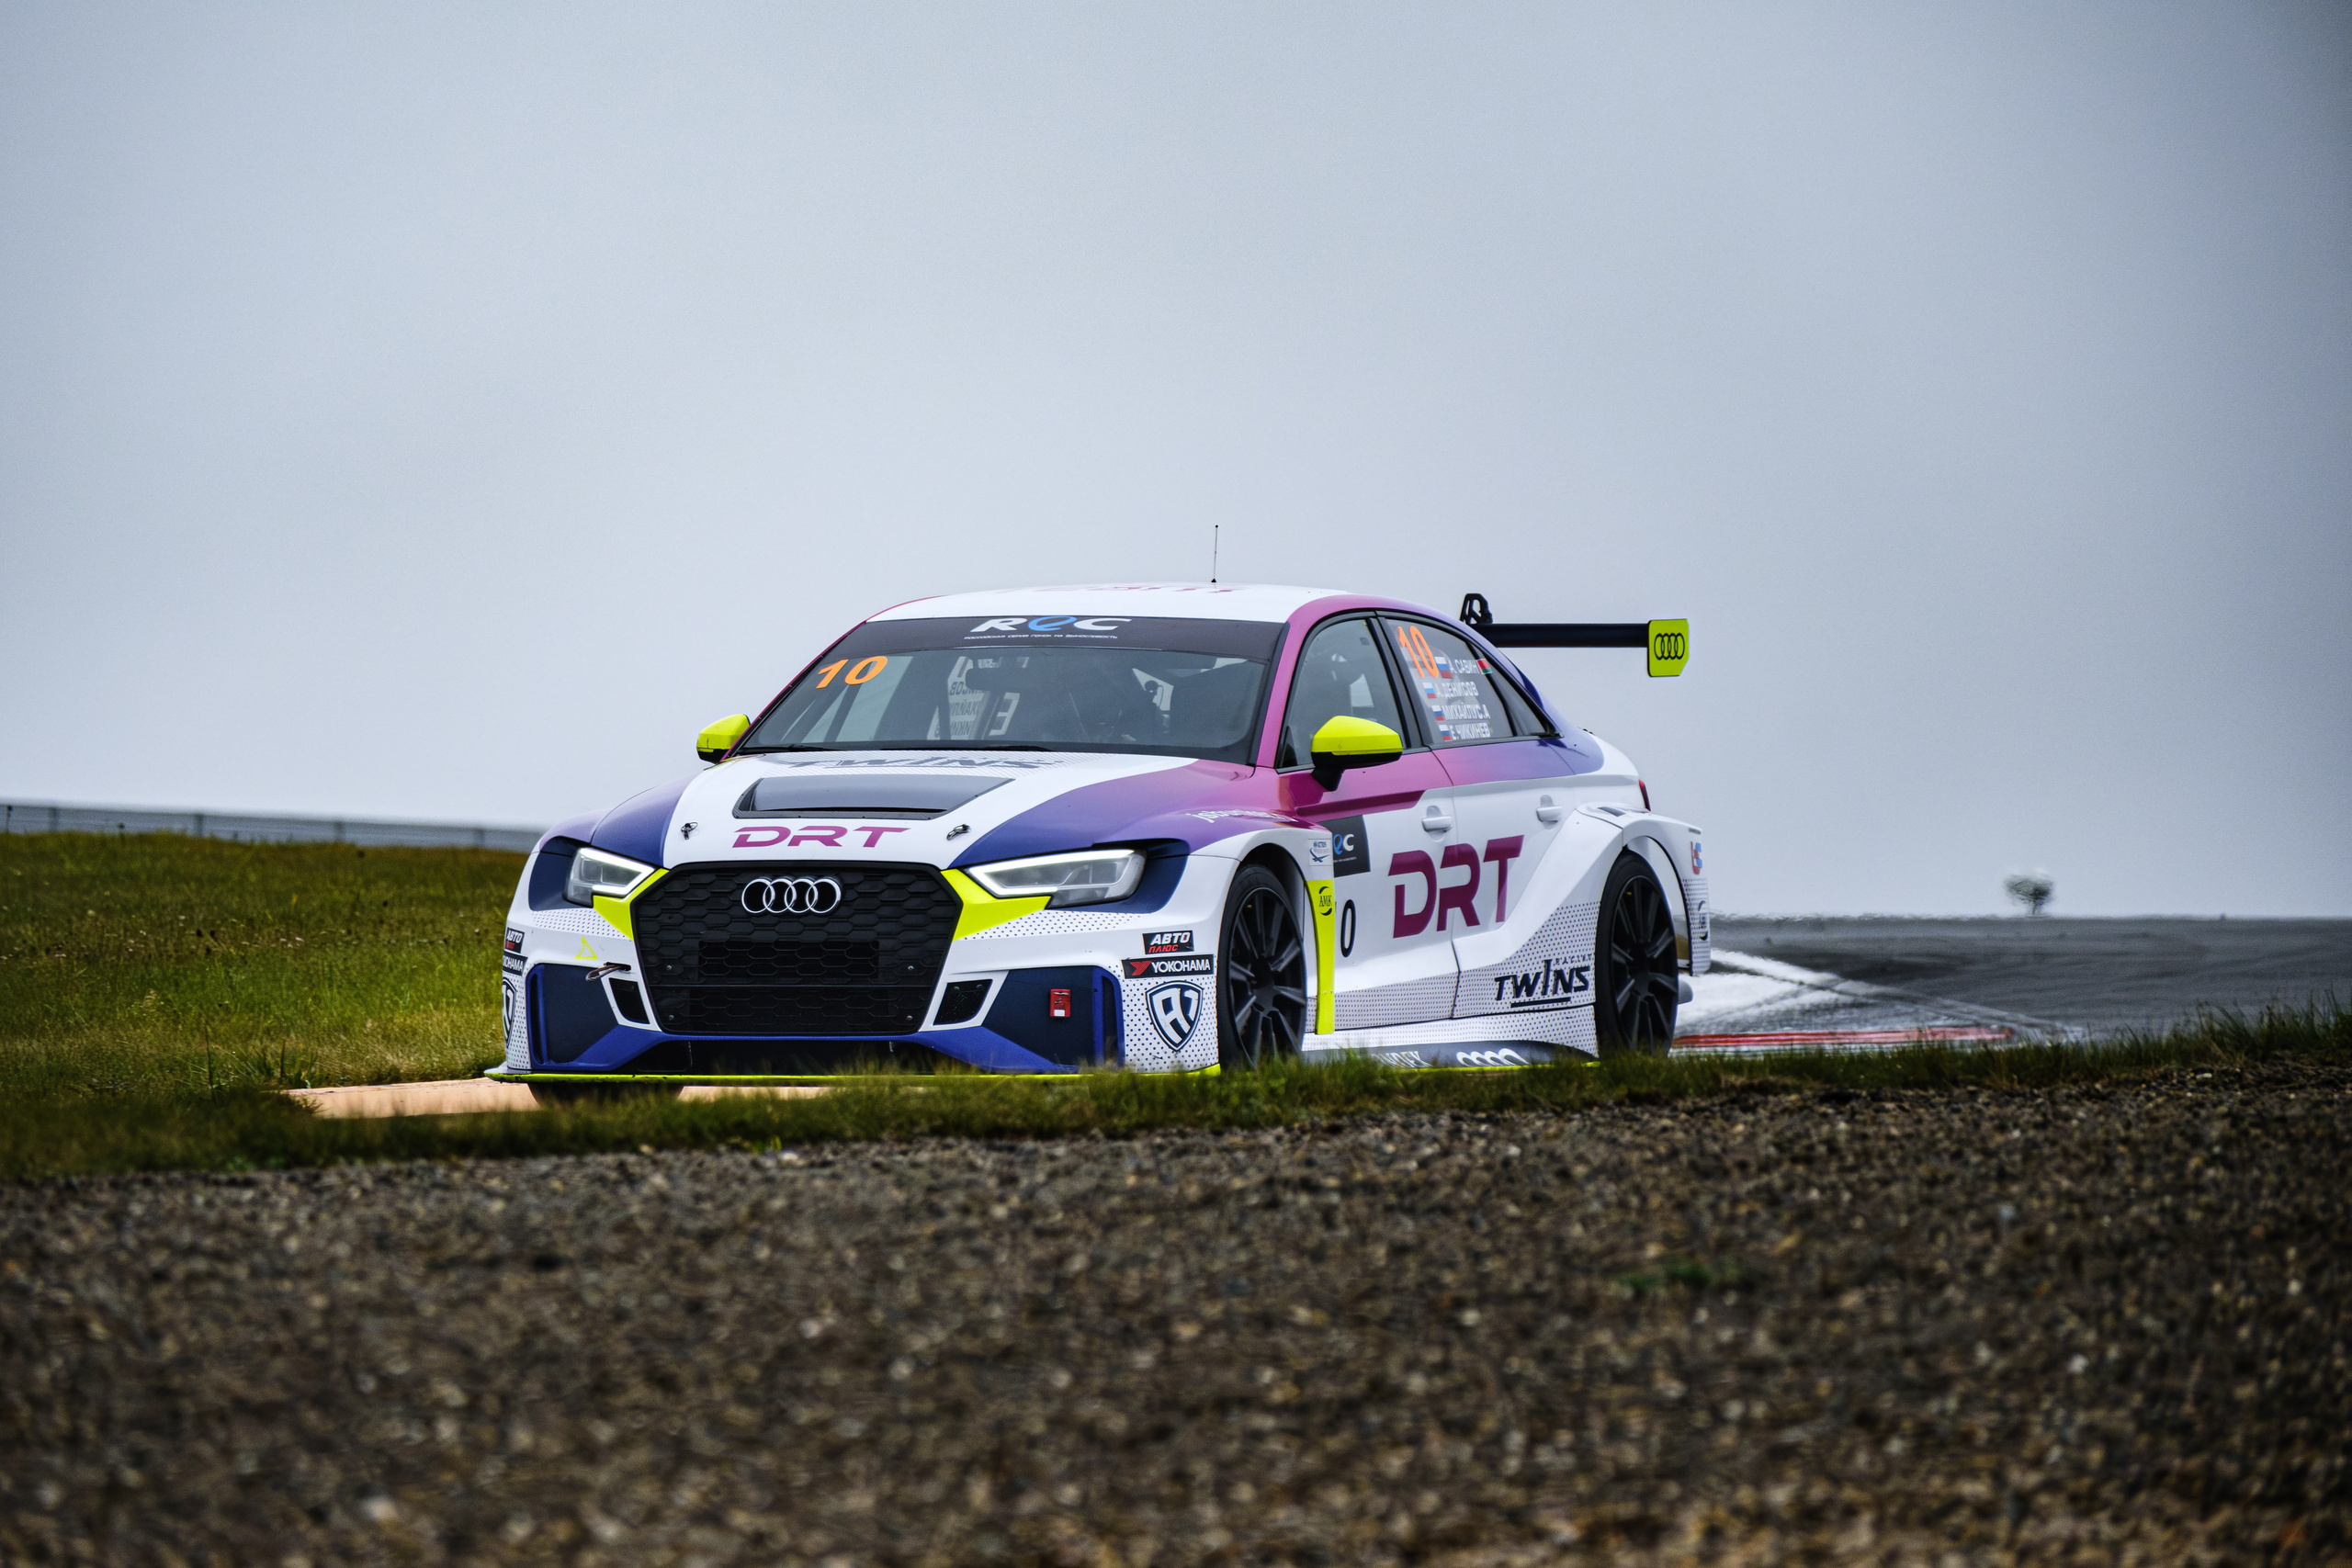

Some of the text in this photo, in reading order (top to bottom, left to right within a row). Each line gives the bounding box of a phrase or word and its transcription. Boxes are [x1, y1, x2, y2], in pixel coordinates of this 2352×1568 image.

[1397, 626, 1439, 678] 10
[816, 656, 888, 689] 10
[732, 826, 911, 848] DRT
[1388, 835, 1524, 939] DRT
[1150, 931, 1191, 946] АВТО
[1335, 898, 1357, 958] 0
[1148, 944, 1179, 953] ПЛЮС
[1151, 958, 1211, 974] YOKOHAMA
[1494, 958, 1590, 1001] TWINS
